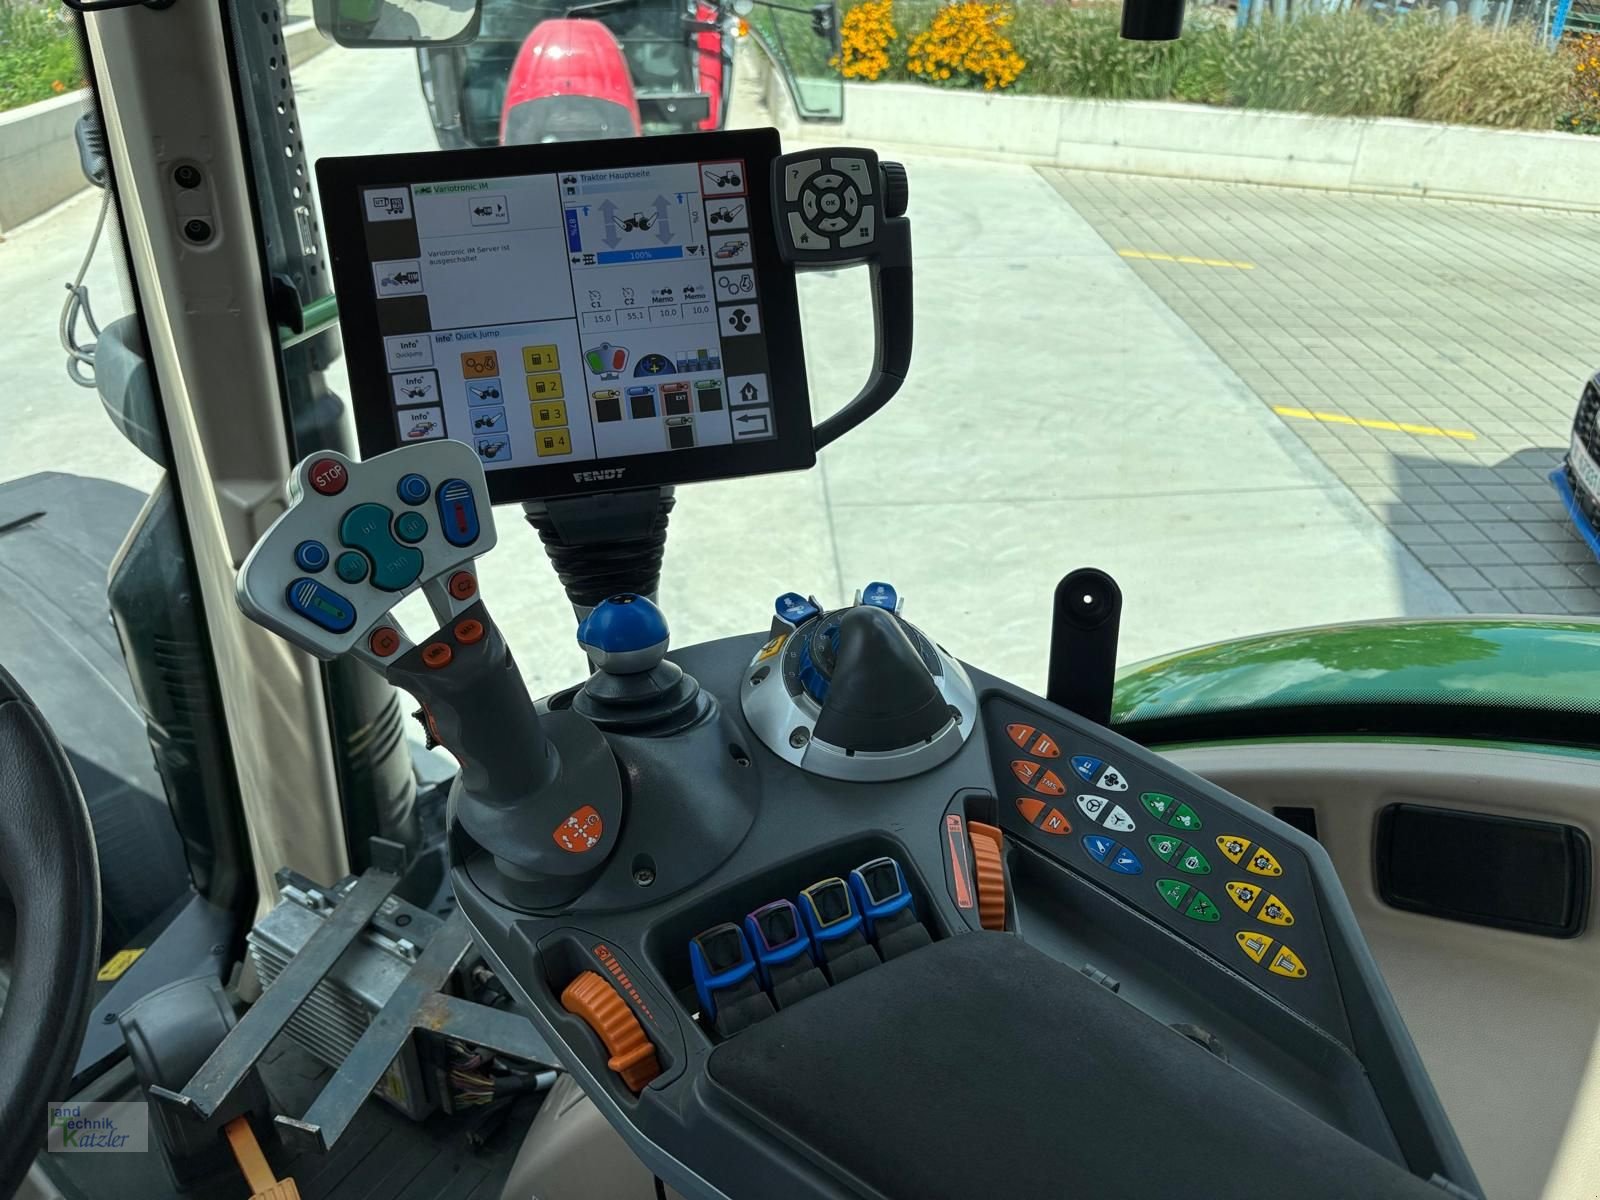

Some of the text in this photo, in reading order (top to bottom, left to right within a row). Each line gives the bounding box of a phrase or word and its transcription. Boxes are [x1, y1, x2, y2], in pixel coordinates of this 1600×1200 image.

[580, 169, 651, 183] Traktor Hauptseite
[433, 182, 478, 193] Variotronic
[427, 248, 465, 257] Variotronic
[476, 245, 500, 253] Server
[630, 251, 652, 260] 100%
[429, 254, 478, 266] ausgeschaltet
[652, 296, 674, 304] Memo
[455, 331, 478, 341] Quick
[480, 330, 500, 339] Jump
[550, 381, 557, 391] 2
[554, 409, 561, 419] 3
[558, 436, 565, 446] 4
[316, 464, 343, 487] STOP
[573, 468, 626, 483] FENDT
[458, 578, 472, 592] C2
[1042, 777, 1057, 790] TMS
[1049, 817, 1061, 829] N
